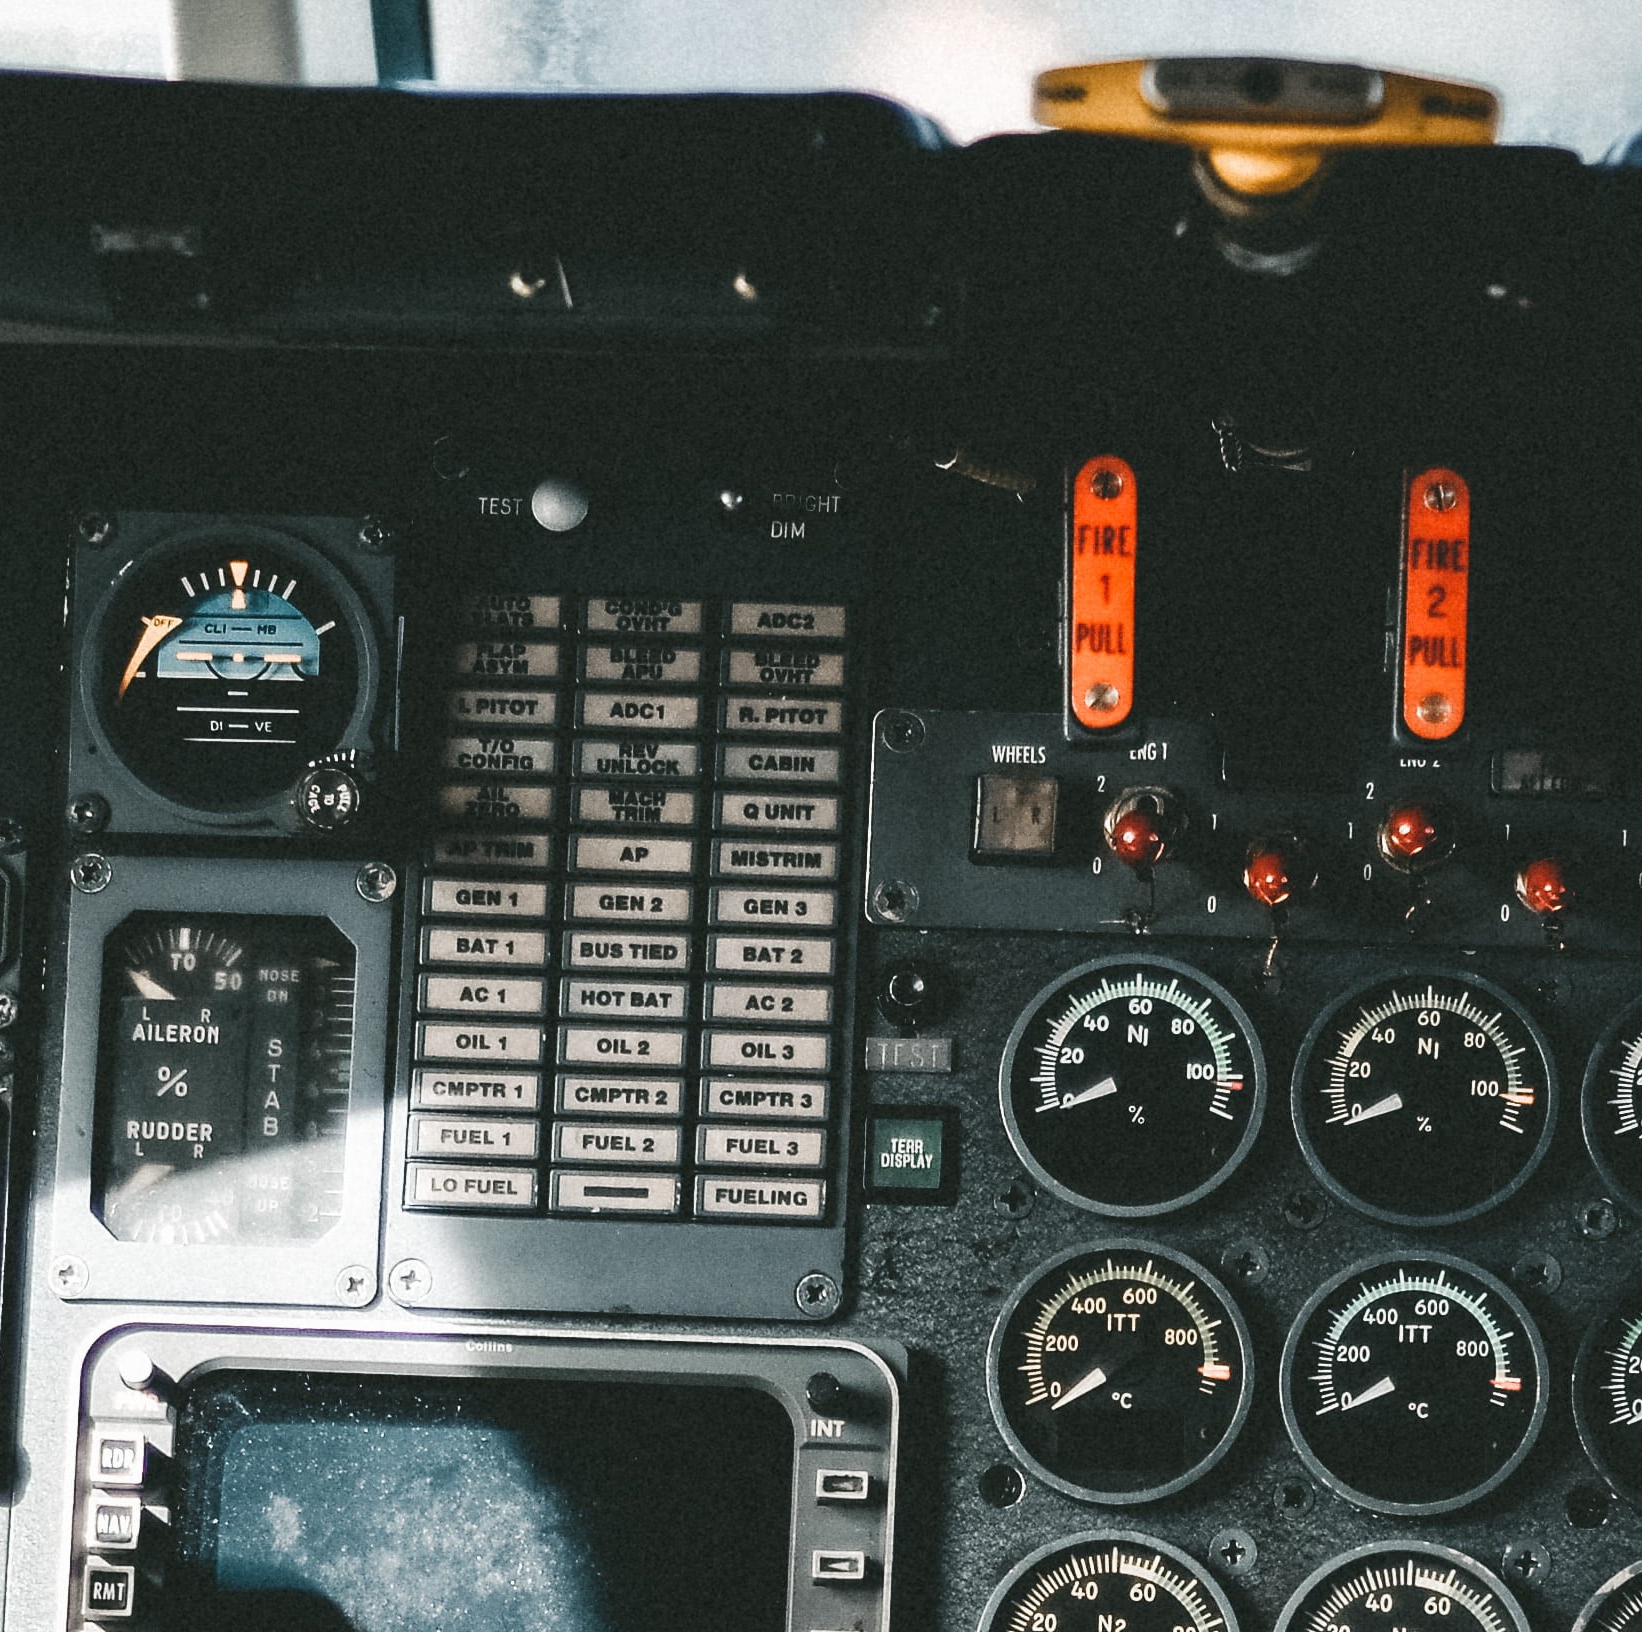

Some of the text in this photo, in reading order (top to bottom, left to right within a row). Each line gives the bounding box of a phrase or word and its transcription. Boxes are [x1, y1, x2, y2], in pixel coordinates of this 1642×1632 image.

[479, 498, 522, 515] TEST
[771, 522, 805, 539] DIM
[1078, 525, 1131, 558] FIRE
[1412, 539, 1466, 572] FIRE
[1100, 574, 1110, 604] 1
[1428, 587, 1447, 618] 2
[758, 613, 814, 629] ADC2
[1076, 623, 1126, 654] PULL
[1409, 636, 1460, 668] PULL
[610, 704, 665, 719] ADC1
[765, 710, 828, 725] PITOT
[992, 745, 1046, 764] WHEELS
[749, 756, 815, 772] CABIN
[744, 805, 814, 820] Q UNIT
[731, 852, 821, 868] MISTRIM
[457, 891, 517, 906] GEN 1
[599, 896, 663, 912] GEN 2
[744, 900, 807, 916] GEN 3
[457, 938, 515, 955] BAT 1
[580, 943, 678, 960] BUS TIED
[743, 948, 802, 963] BAT 2
[581, 991, 672, 1008] HOT BAT
[132, 1023, 219, 1044] AILERON
[1186, 1063, 1214, 1080] 100
[433, 1081, 523, 1099] CMPTR 1
[575, 1087, 667, 1104] CMPTR 2
[720, 1091, 812, 1108] CMPTR 3
[127, 1121, 212, 1141] RUDDER
[441, 1129, 511, 1146] FUEL 1
[582, 1135, 655, 1152] FUEL 2
[726, 1139, 798, 1156] FUEL 3
[891, 1138, 923, 1154] TERR
[881, 1154, 932, 1169] DISPLAY
[431, 1178, 517, 1195] LO FUEL
[716, 1190, 808, 1206] FUELING
[1107, 1314, 1140, 1332] ITT
[810, 1418, 843, 1437] INT
[93, 1581, 125, 1603] RMT
